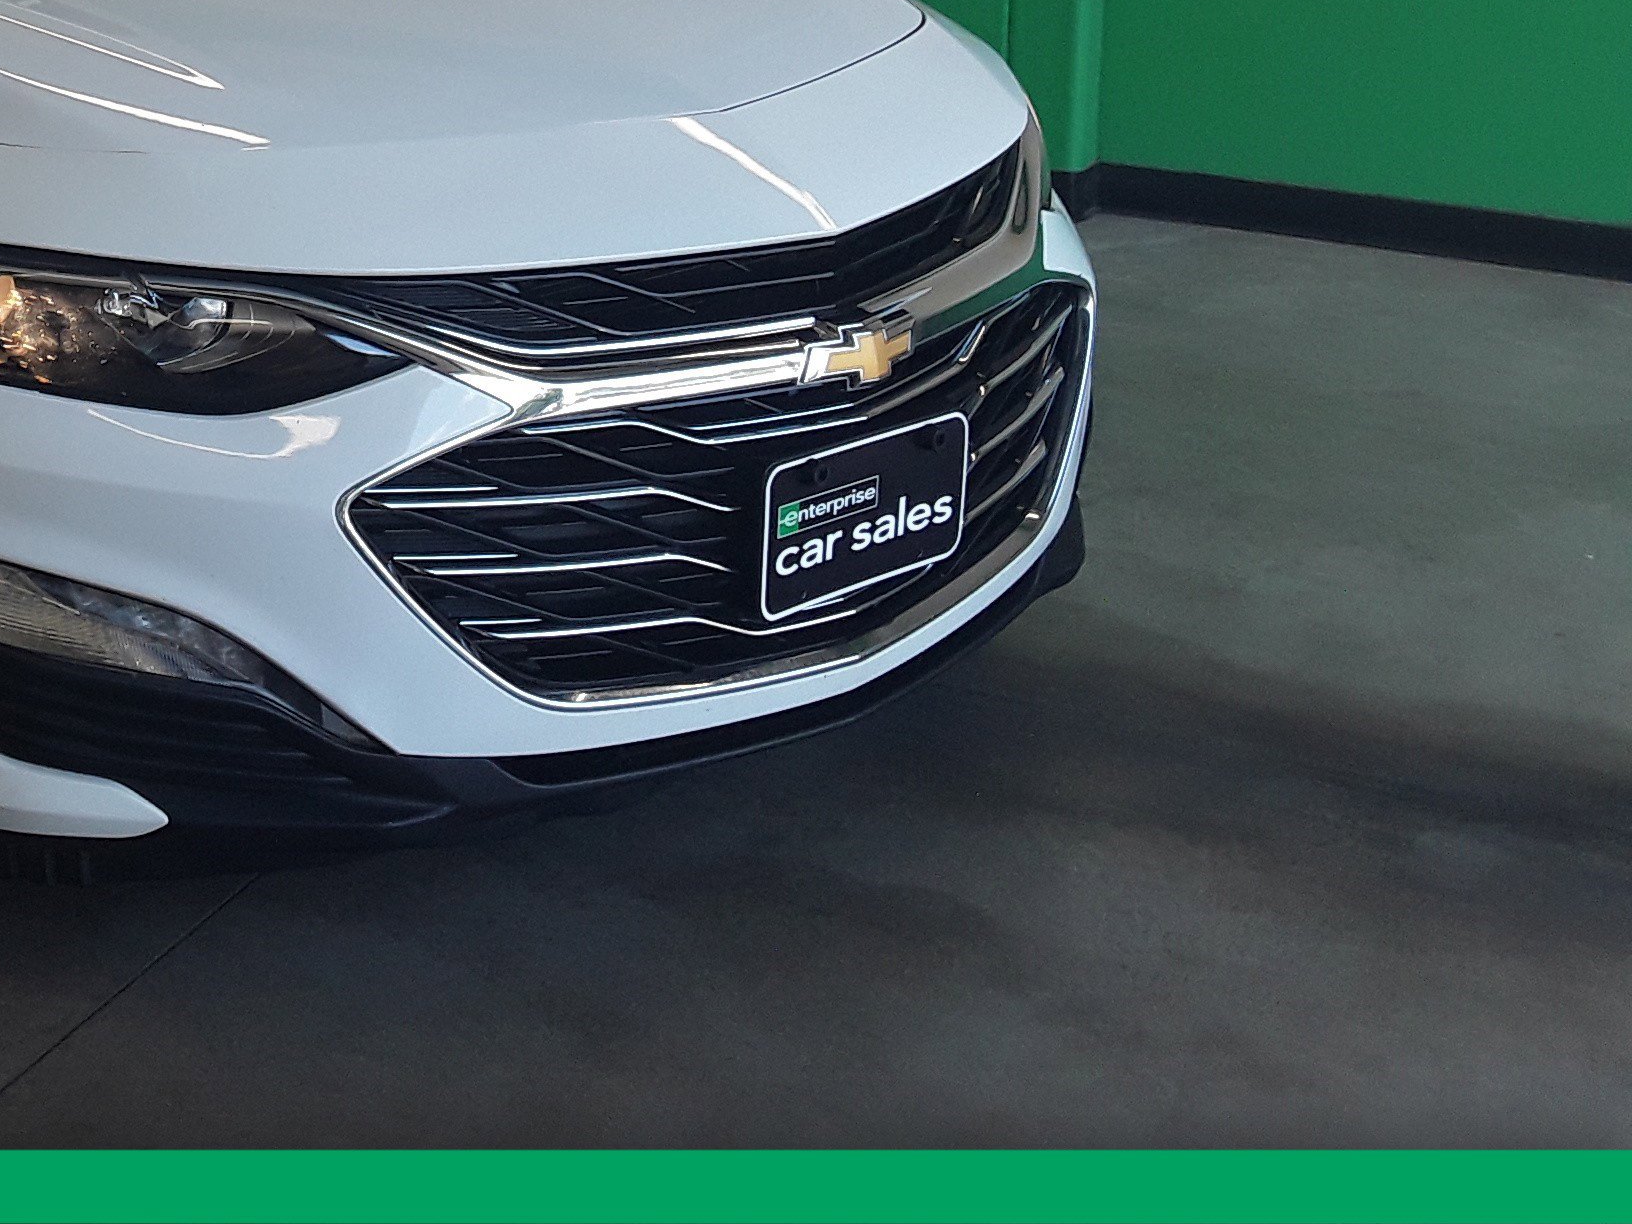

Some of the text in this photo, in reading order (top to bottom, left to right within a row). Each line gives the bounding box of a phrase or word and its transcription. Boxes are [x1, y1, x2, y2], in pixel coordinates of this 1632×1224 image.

[775, 494, 954, 576] car sales
[782, 486, 876, 527] enterprise
